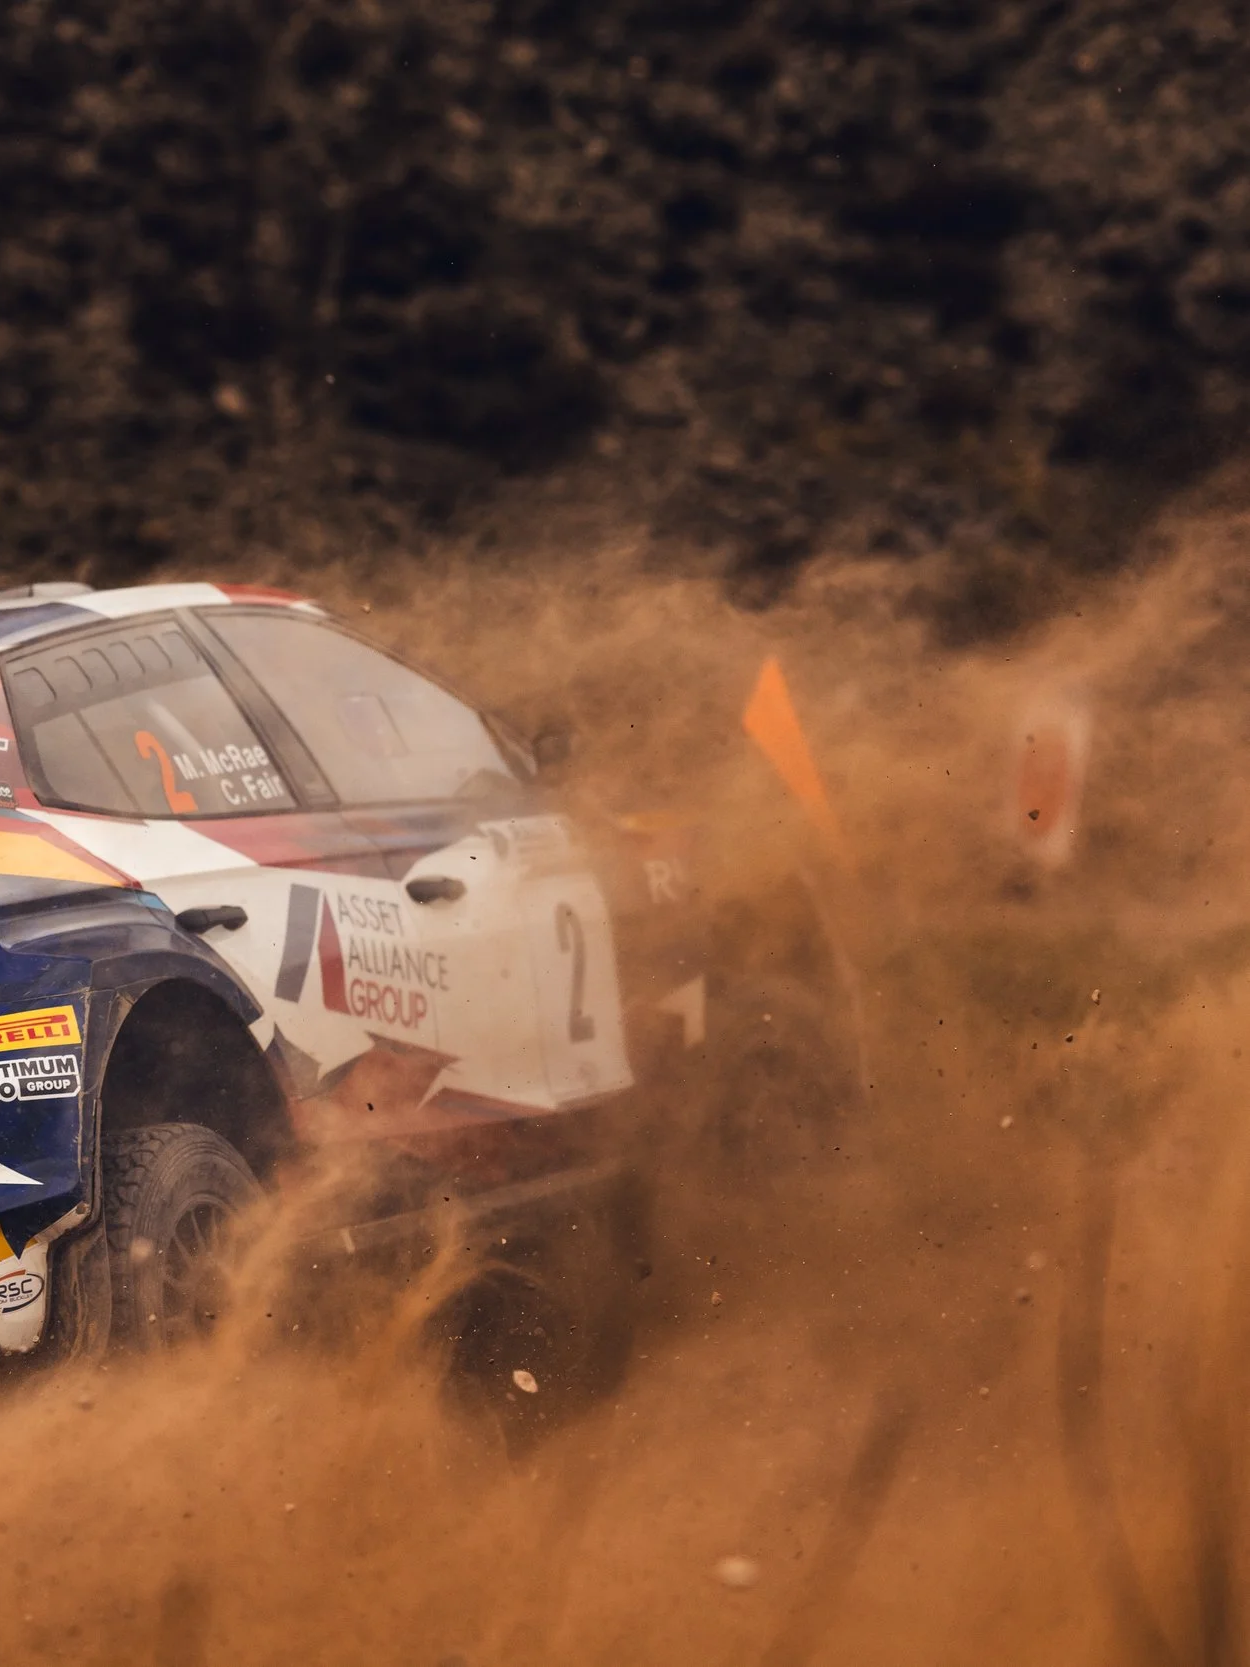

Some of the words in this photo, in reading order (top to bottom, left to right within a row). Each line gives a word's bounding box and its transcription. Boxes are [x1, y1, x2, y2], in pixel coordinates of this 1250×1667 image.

[134, 730, 199, 814] 2
[173, 753, 205, 780] M.
[200, 743, 270, 776] McRae
[220, 778, 248, 805] C.
[241, 771, 286, 801] Fair
[338, 891, 405, 937] ASSET
[348, 936, 450, 991] ALLIANCE
[554, 903, 596, 1045] 2
[350, 978, 428, 1029] GROUP
[26, 1079, 71, 1092] GROUP
